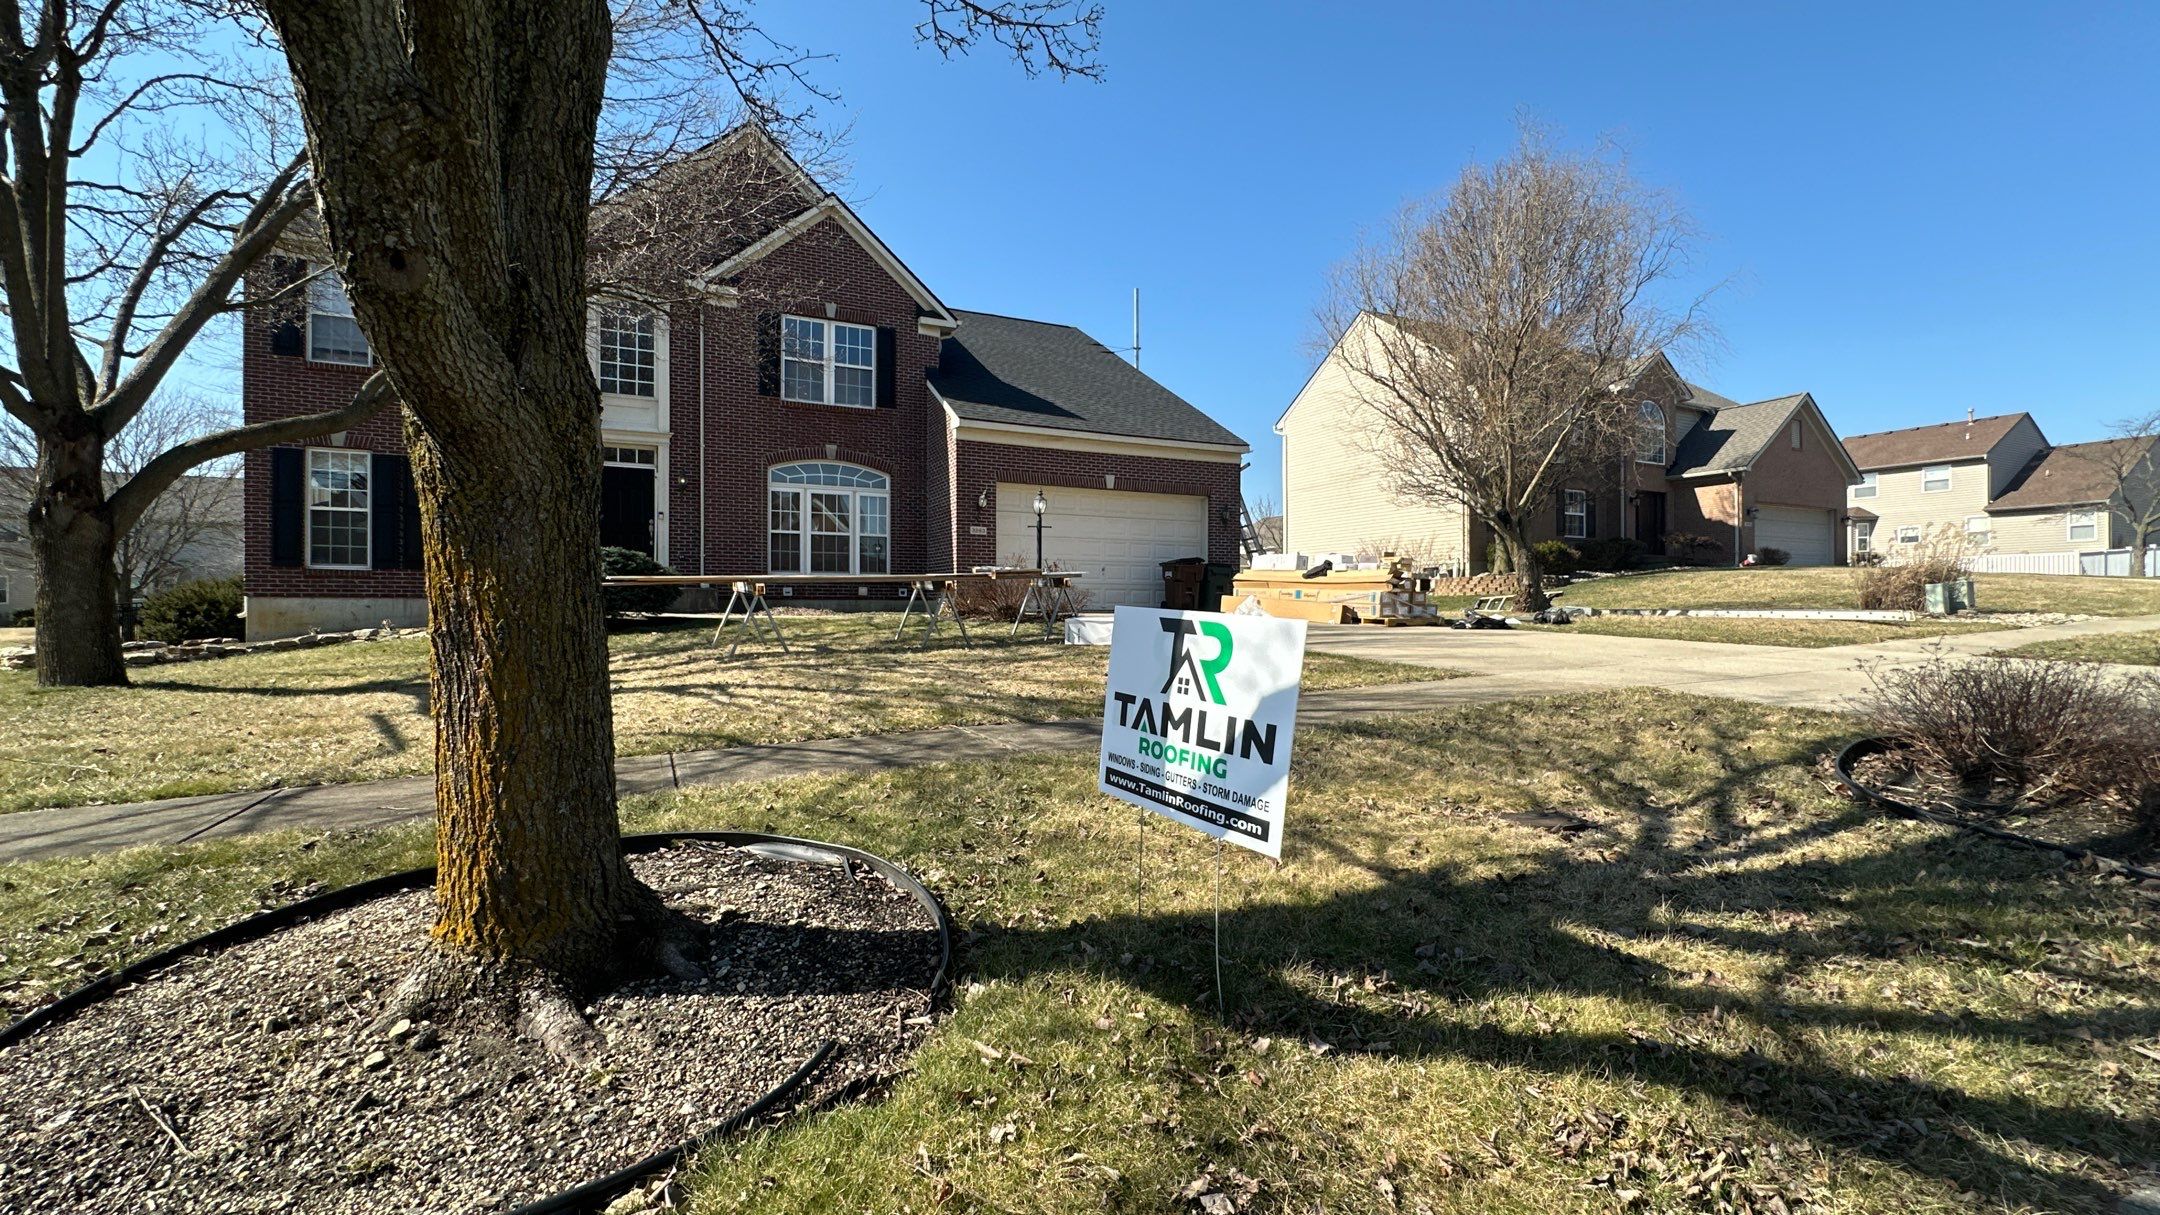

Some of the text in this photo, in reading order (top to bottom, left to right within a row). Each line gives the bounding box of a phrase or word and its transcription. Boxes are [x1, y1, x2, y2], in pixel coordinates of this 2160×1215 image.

[1114, 691, 1277, 765] TAMLIN
[1138, 737, 1227, 779] ROOFING
[1107, 751, 1136, 769] WINDOWS
[1139, 762, 1161, 778] SIDING
[1165, 770, 1197, 790] GUTTERS
[1202, 782, 1230, 801] STORM
[1231, 790, 1270, 813] DAMAGE
[1109, 774, 1262, 835] www.TamlinRoofing.com
